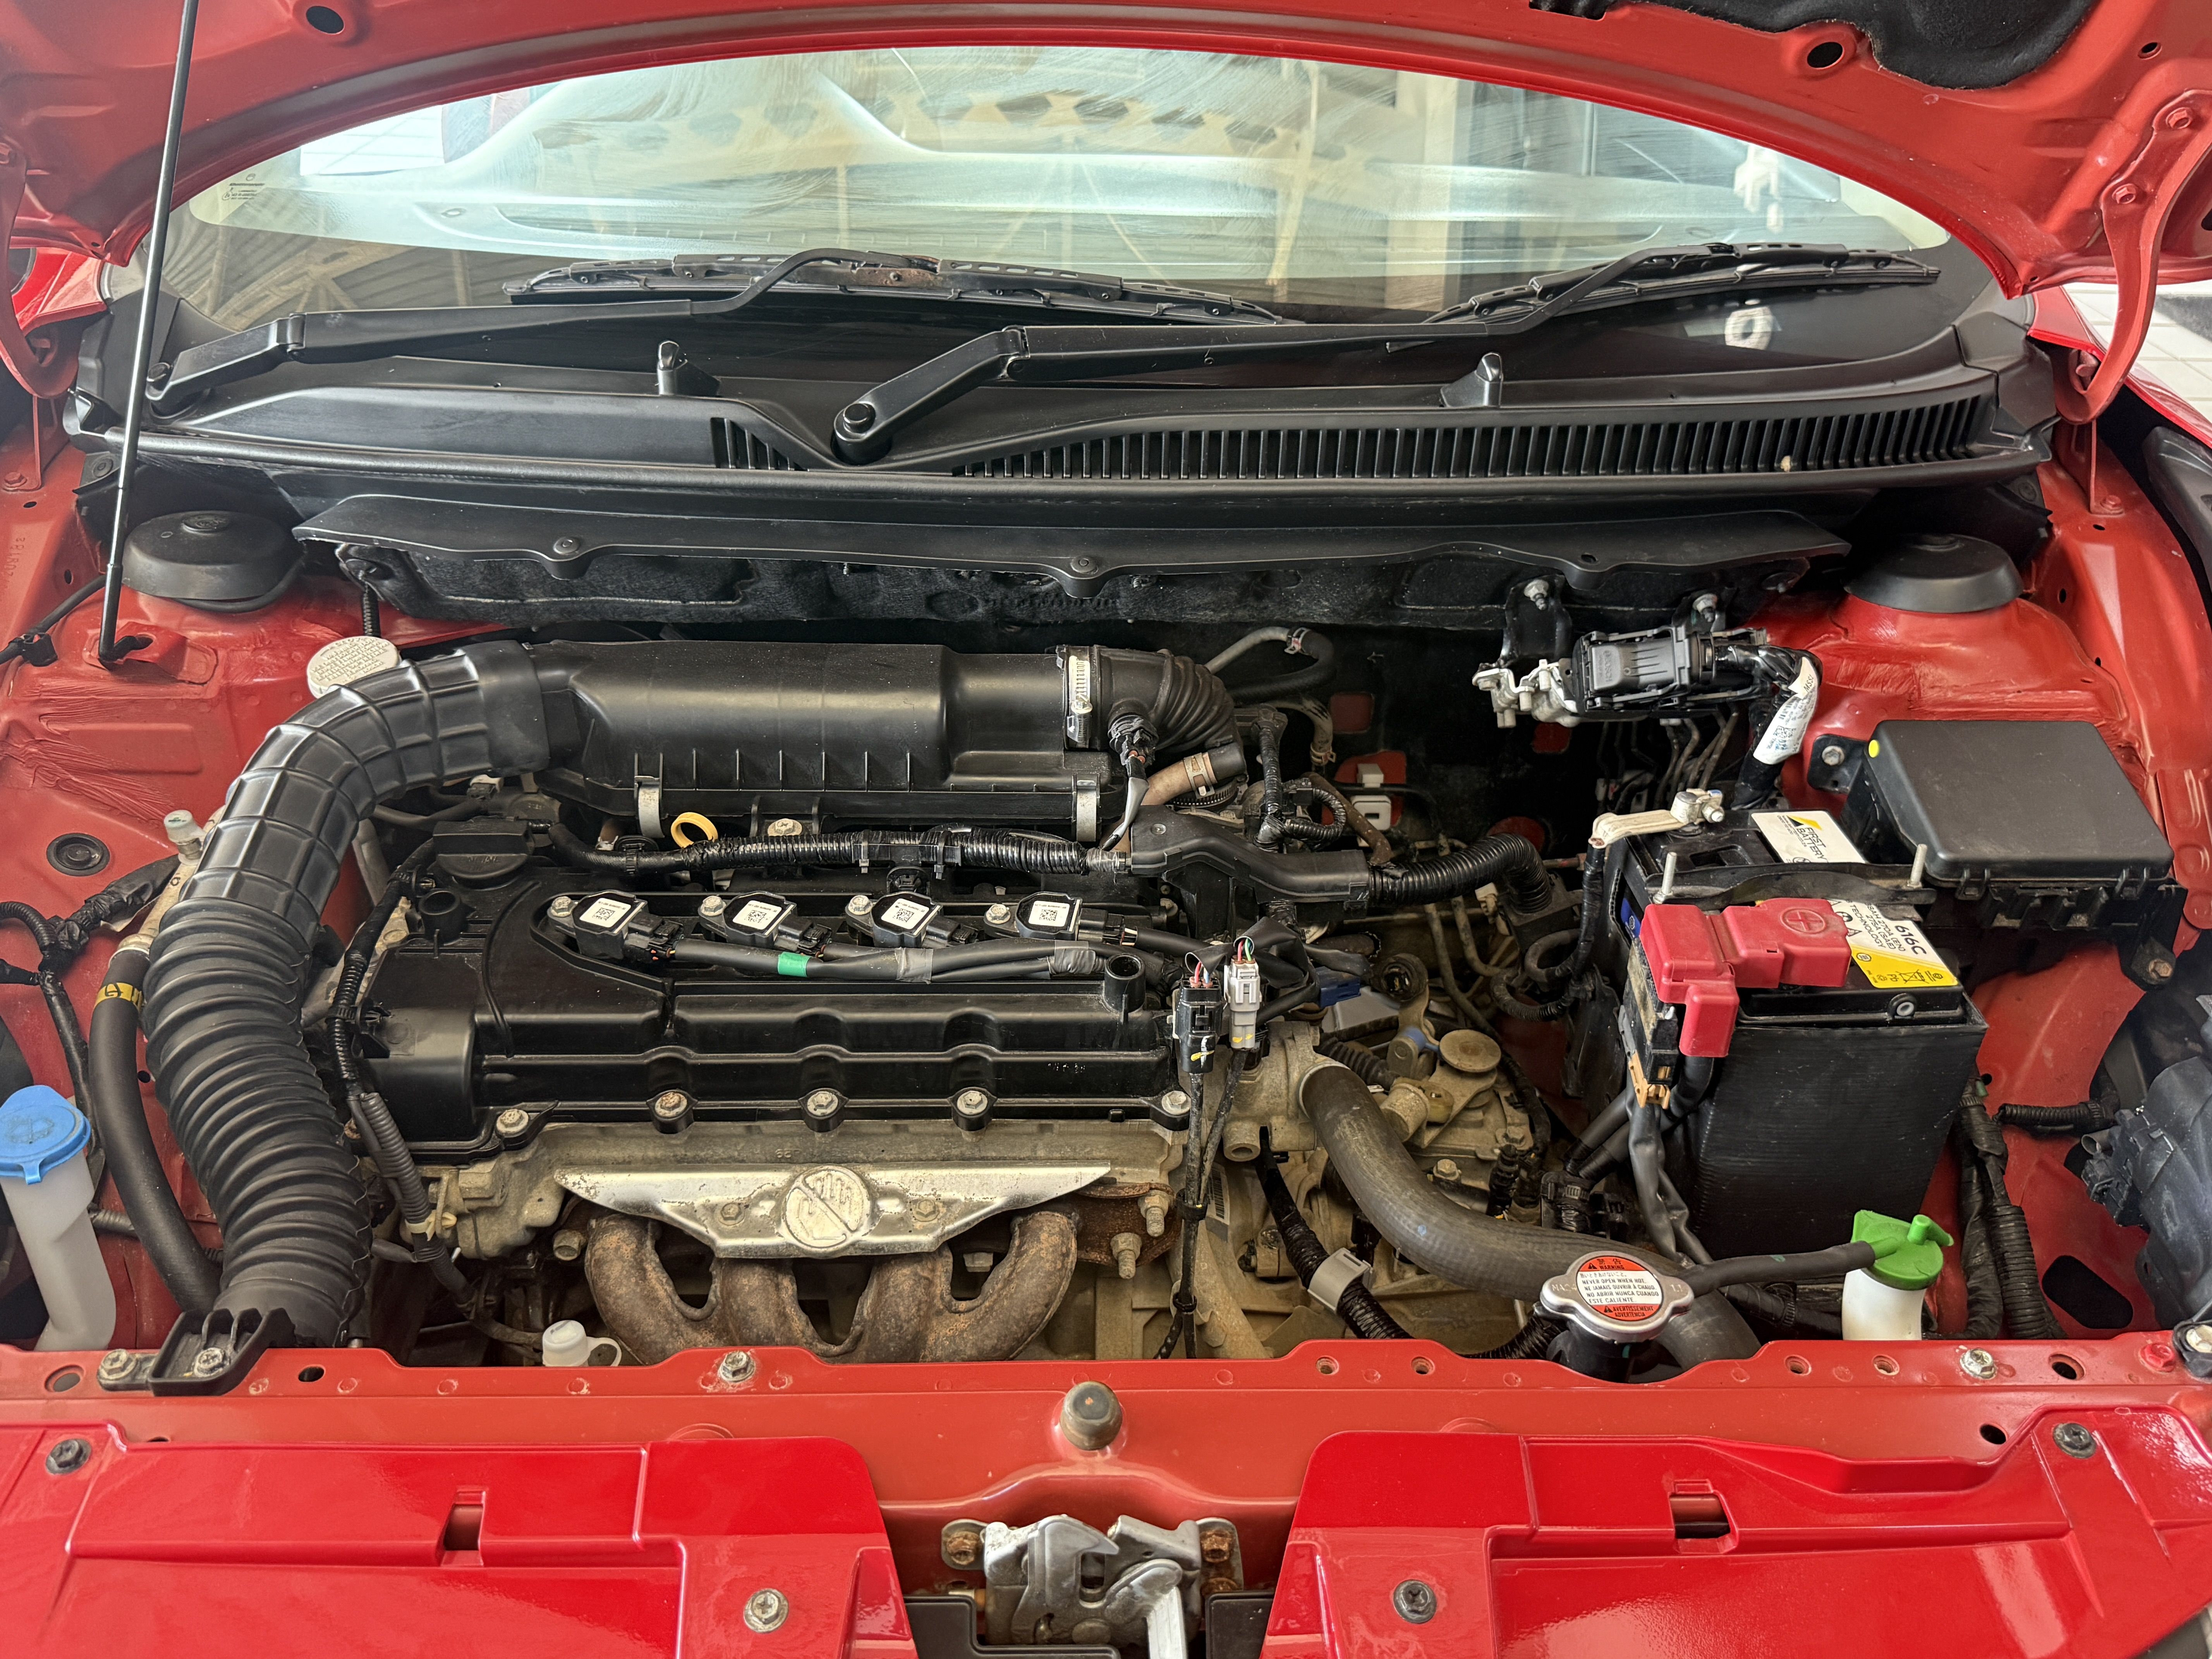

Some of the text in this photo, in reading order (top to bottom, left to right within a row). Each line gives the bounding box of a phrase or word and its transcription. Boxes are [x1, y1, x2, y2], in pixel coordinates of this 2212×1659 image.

[1796, 828, 1827, 861] BATTERY
[1805, 827, 1826, 848] FIRST
[1850, 904, 1886, 948] TECHNOLOGY
[1865, 915, 1896, 949] 275A (SAE)
[1877, 920, 1894, 936] 270A
[1891, 938, 1906, 951] (EN)
[1894, 925, 1927, 955] 616C
